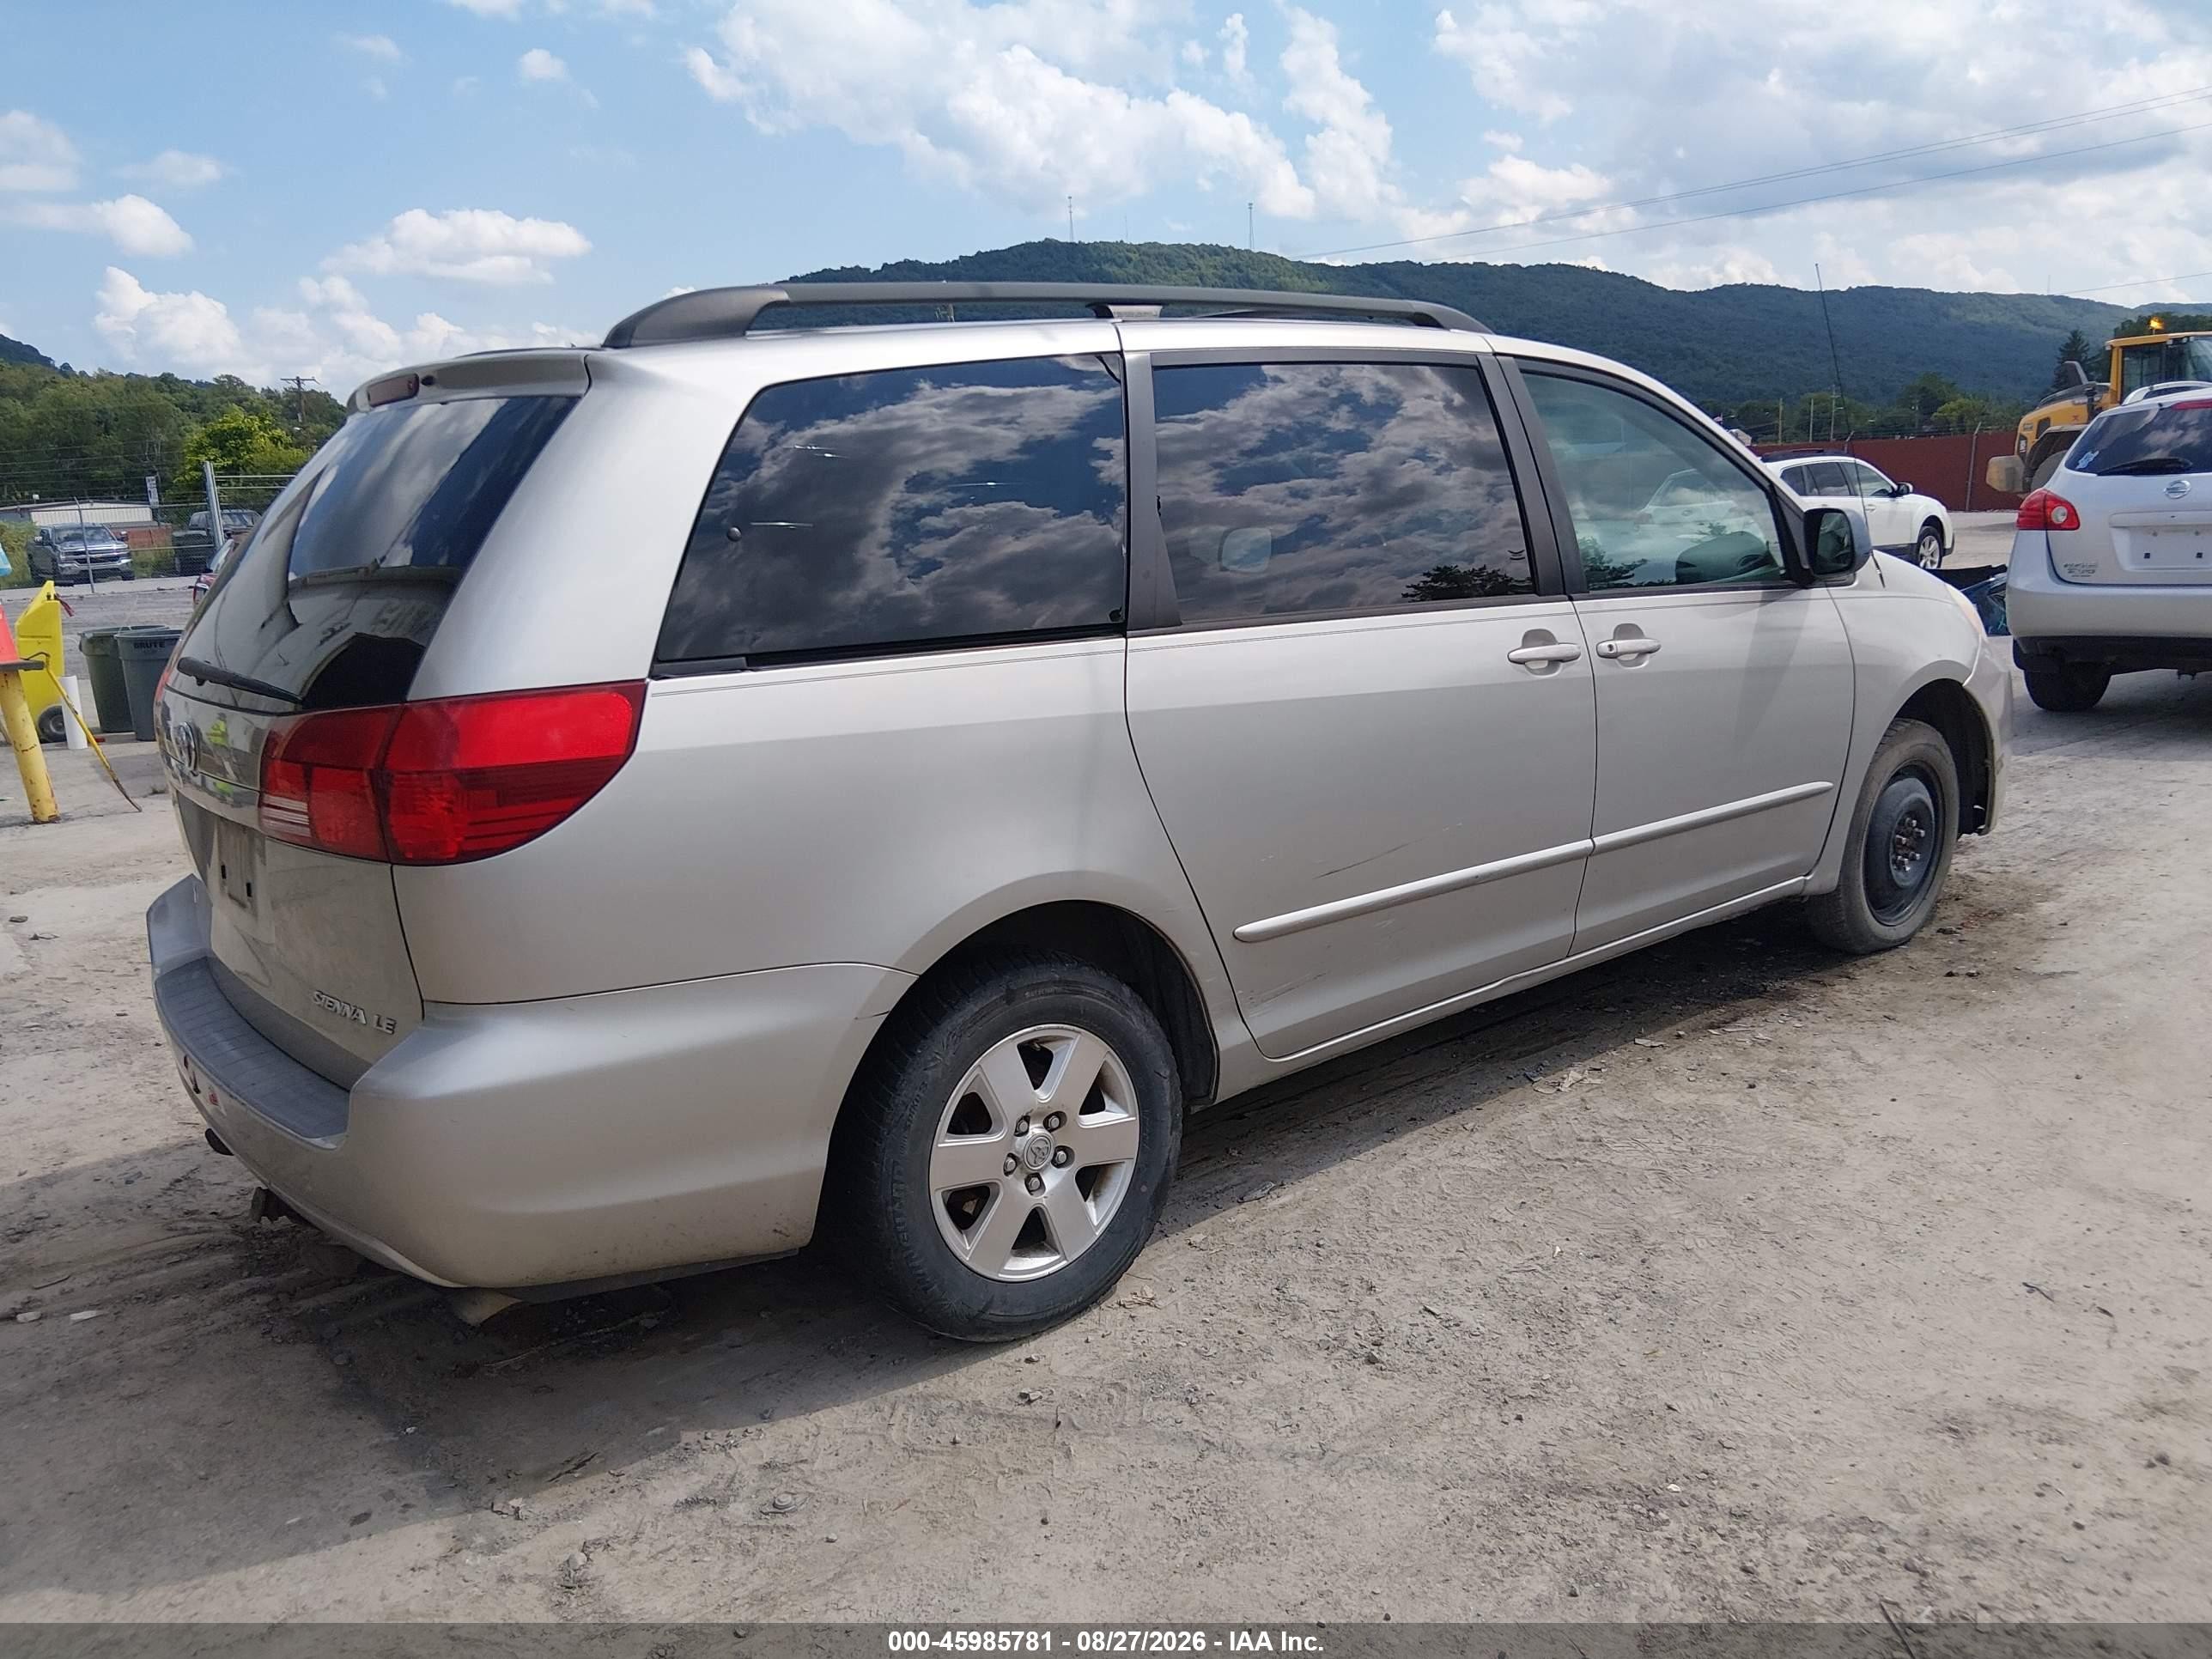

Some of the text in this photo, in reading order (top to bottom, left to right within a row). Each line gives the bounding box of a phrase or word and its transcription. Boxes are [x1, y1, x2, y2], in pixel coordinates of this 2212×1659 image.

[133, 641, 166, 649] BRUTE
[312, 989, 397, 1035] SIENNA LE
